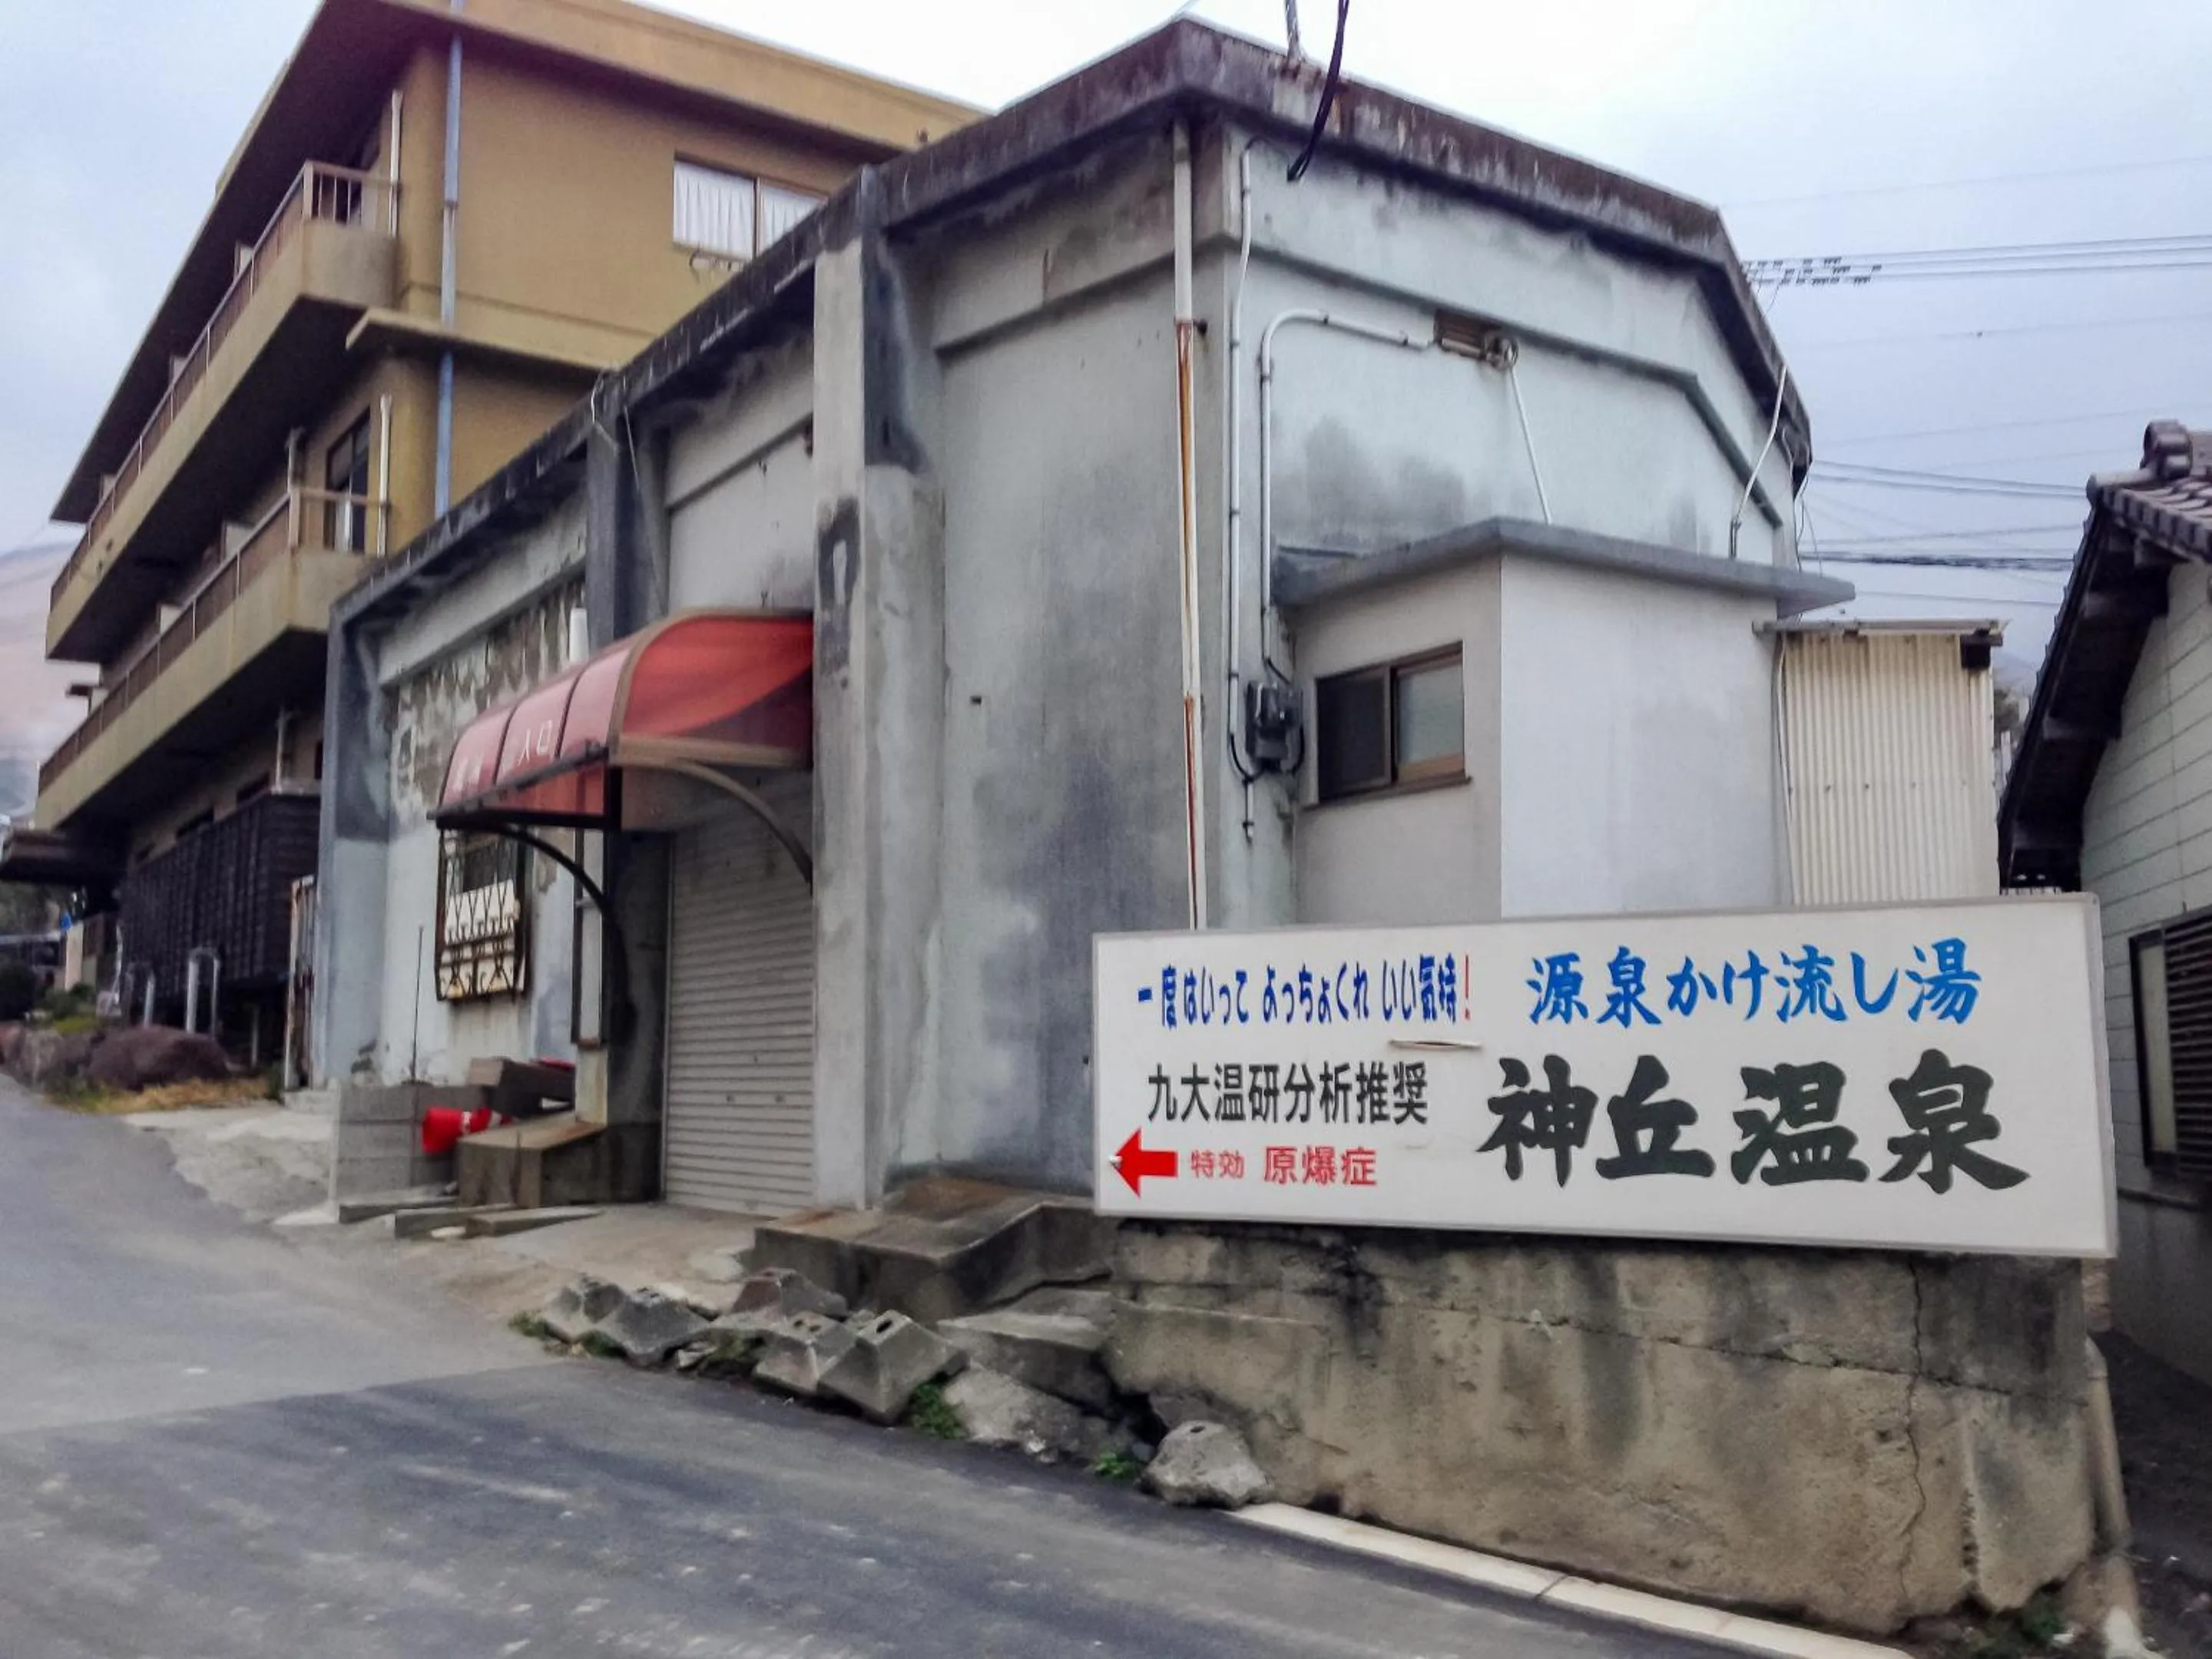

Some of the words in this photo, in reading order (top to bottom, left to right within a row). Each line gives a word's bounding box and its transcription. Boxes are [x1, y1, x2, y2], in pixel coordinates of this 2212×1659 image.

[1263, 965, 1369, 1024] よっちょくれ
[1525, 938, 1982, 1028] 源泉かけ流し湯
[1148, 1061, 1428, 1125] 九大温研分析推奨
[1475, 1048, 2031, 1194] 神丘温泉
[1190, 1149, 1245, 1180] 特効
[1263, 1145, 1378, 1187] 原爆症
